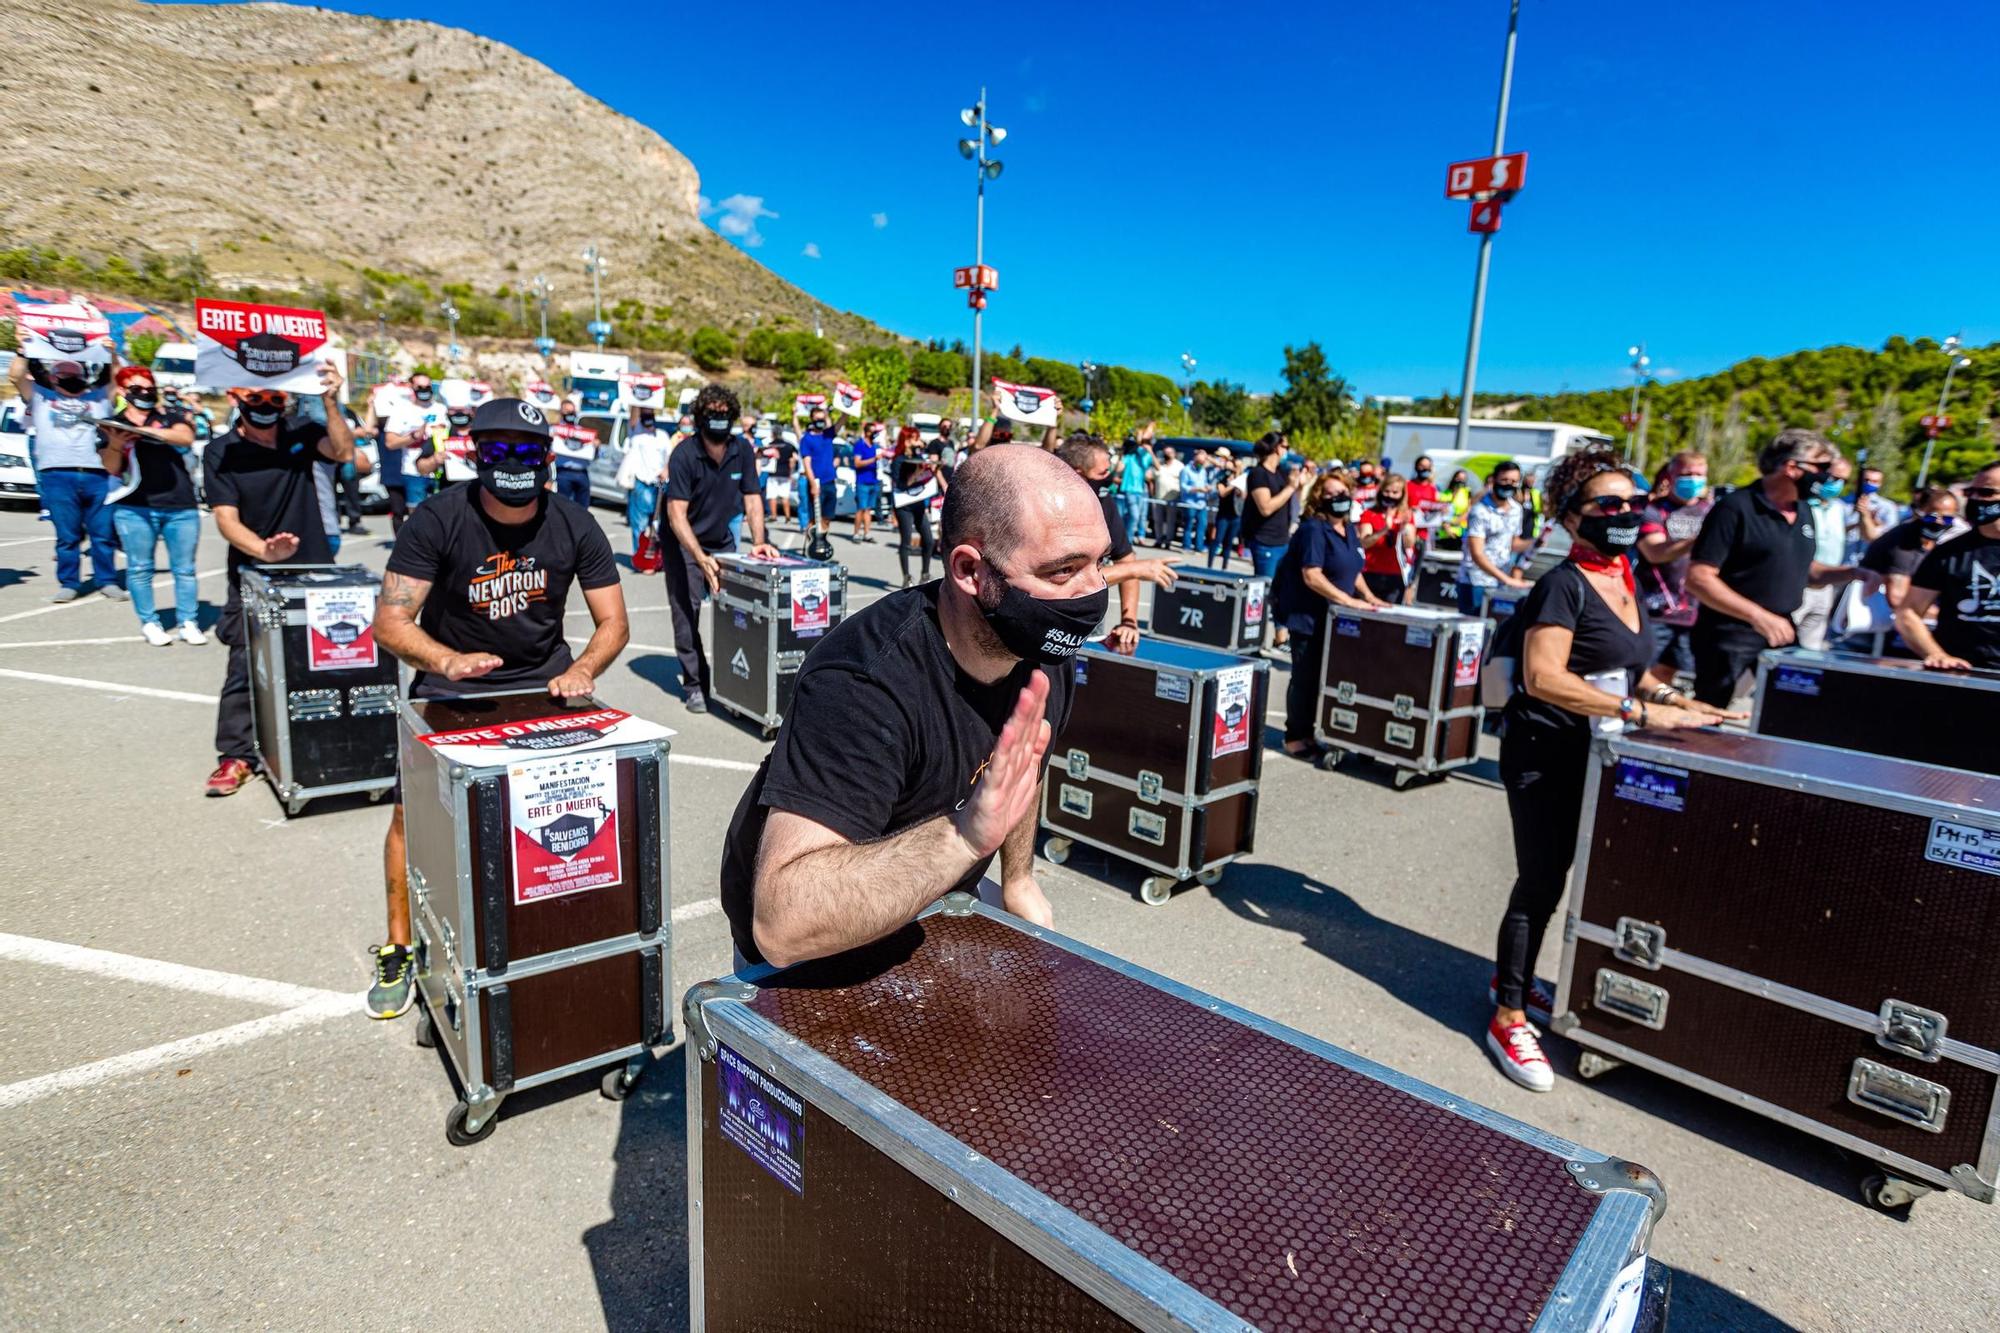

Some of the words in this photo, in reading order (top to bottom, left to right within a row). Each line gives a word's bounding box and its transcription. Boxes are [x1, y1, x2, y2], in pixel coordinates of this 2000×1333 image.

[201, 308, 246, 332] ERTE
[250, 312, 262, 334] O
[264, 314, 325, 339] MUERTE
[486, 551, 517, 578] The
[468, 569, 546, 604] NEWTRON
[489, 591, 529, 621] BOYS
[1179, 606, 1204, 629] 7R
[428, 729, 501, 745] ERTE
[501, 726, 525, 736] O
[524, 710, 622, 733] MUERTE
[528, 805, 553, 819] ERTE
[556, 803, 562, 814] O
[566, 796, 603, 812] MUERTE
[544, 825, 588, 843] #SALVEMOS
[552, 836, 589, 853] BENIDORM
[720, 1048, 737, 1068] SPACE
[737, 1058, 759, 1086] SUPPORT
[760, 1075, 802, 1117] PRODUCCIONES
